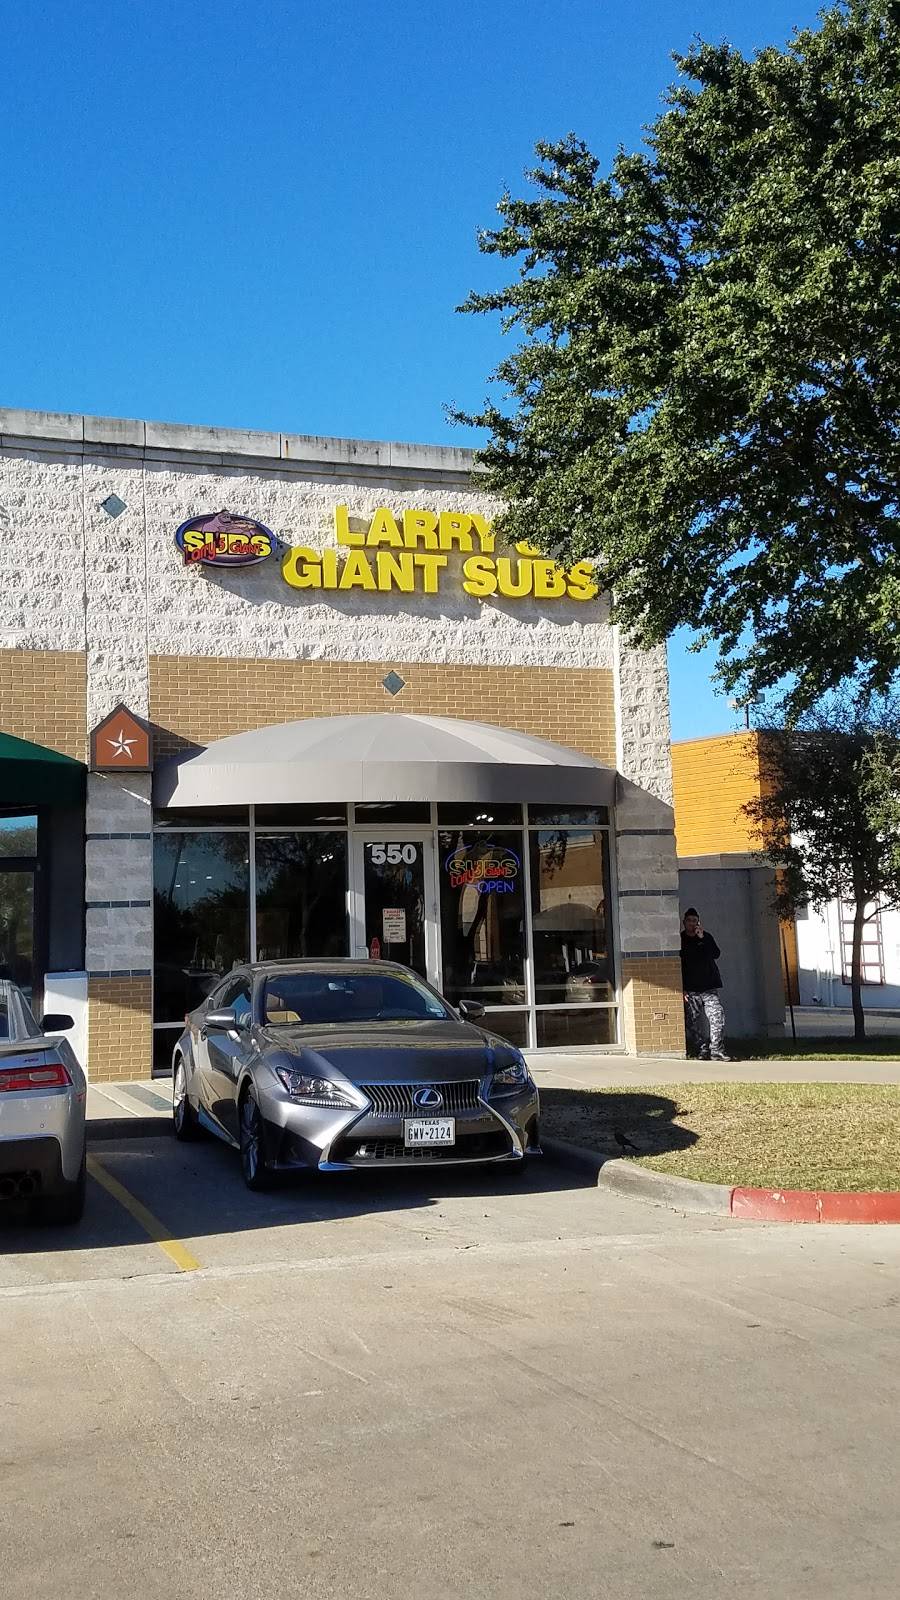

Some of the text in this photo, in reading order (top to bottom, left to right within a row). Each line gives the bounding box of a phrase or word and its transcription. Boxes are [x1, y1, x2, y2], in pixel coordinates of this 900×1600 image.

[183, 531, 272, 557] SUBS
[281, 545, 599, 600] GIANT SUBS
[371, 844, 417, 865] 550
[449, 859, 518, 878] SUBS
[477, 881, 515, 893] OPEN
